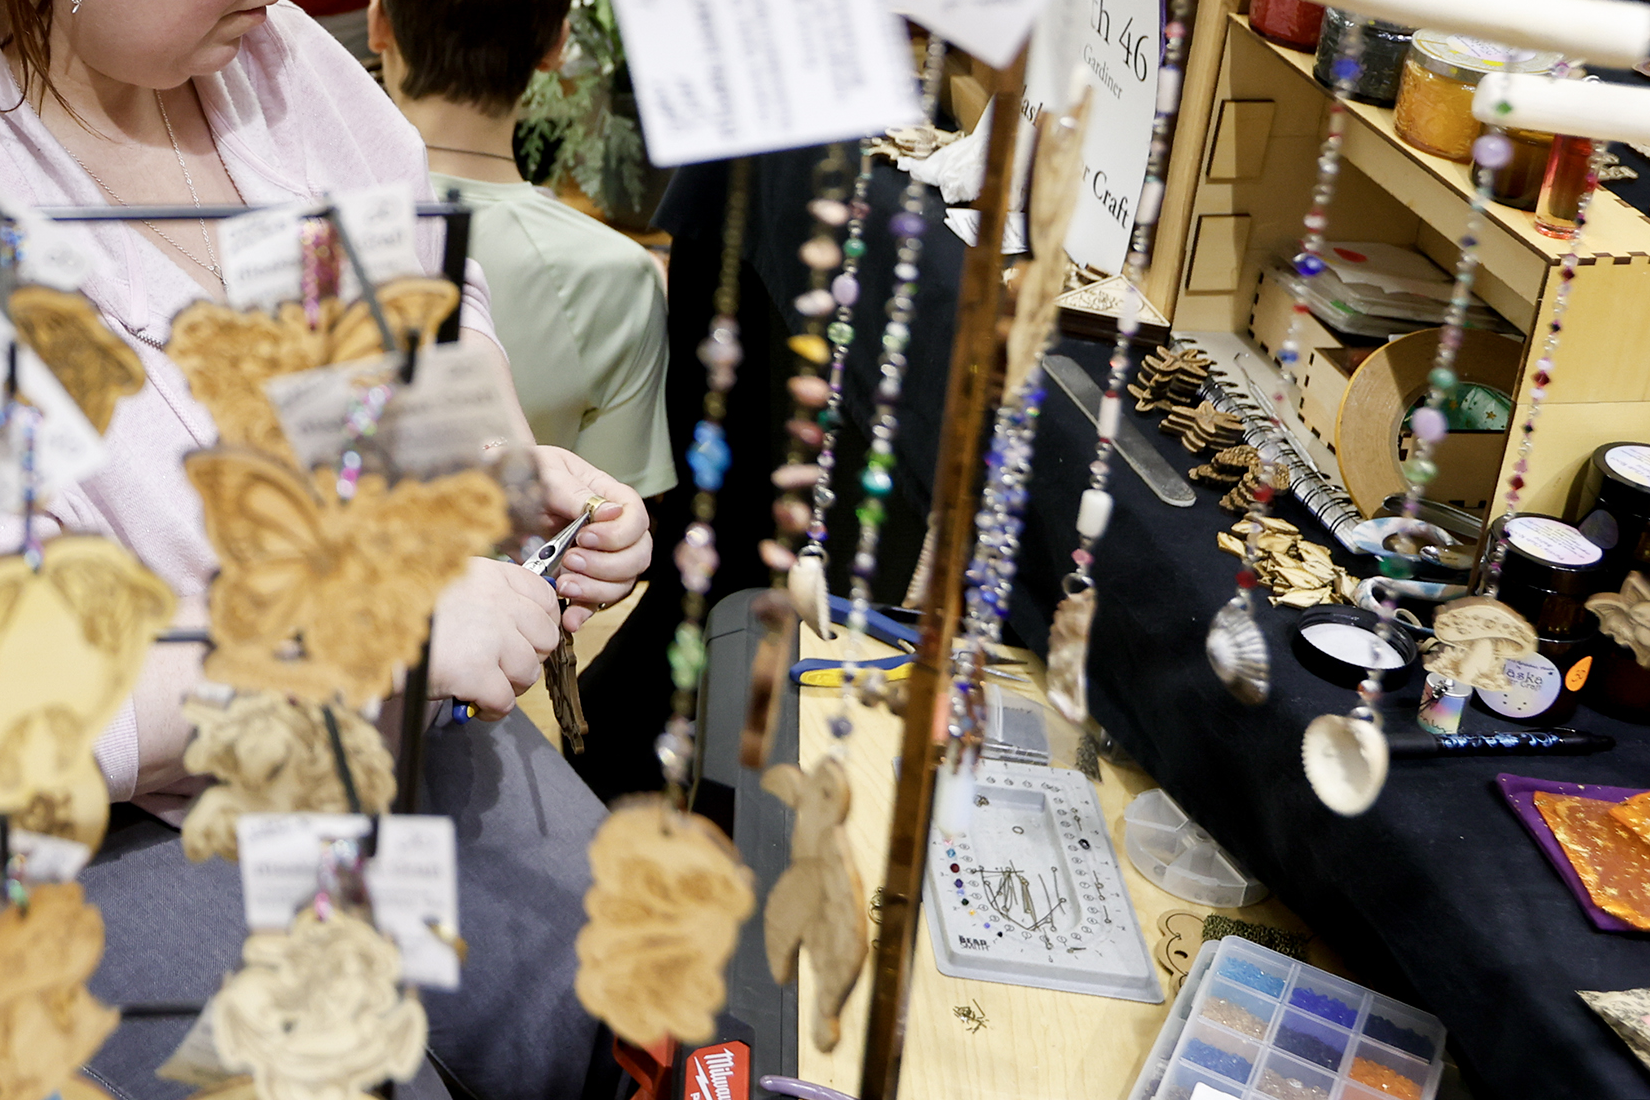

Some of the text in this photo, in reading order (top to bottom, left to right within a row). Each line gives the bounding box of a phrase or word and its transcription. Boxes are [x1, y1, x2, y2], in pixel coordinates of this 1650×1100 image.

[1083, 44, 1123, 101] Gardiner
[1118, 16, 1149, 82] 46
[1092, 169, 1132, 230] Craft
